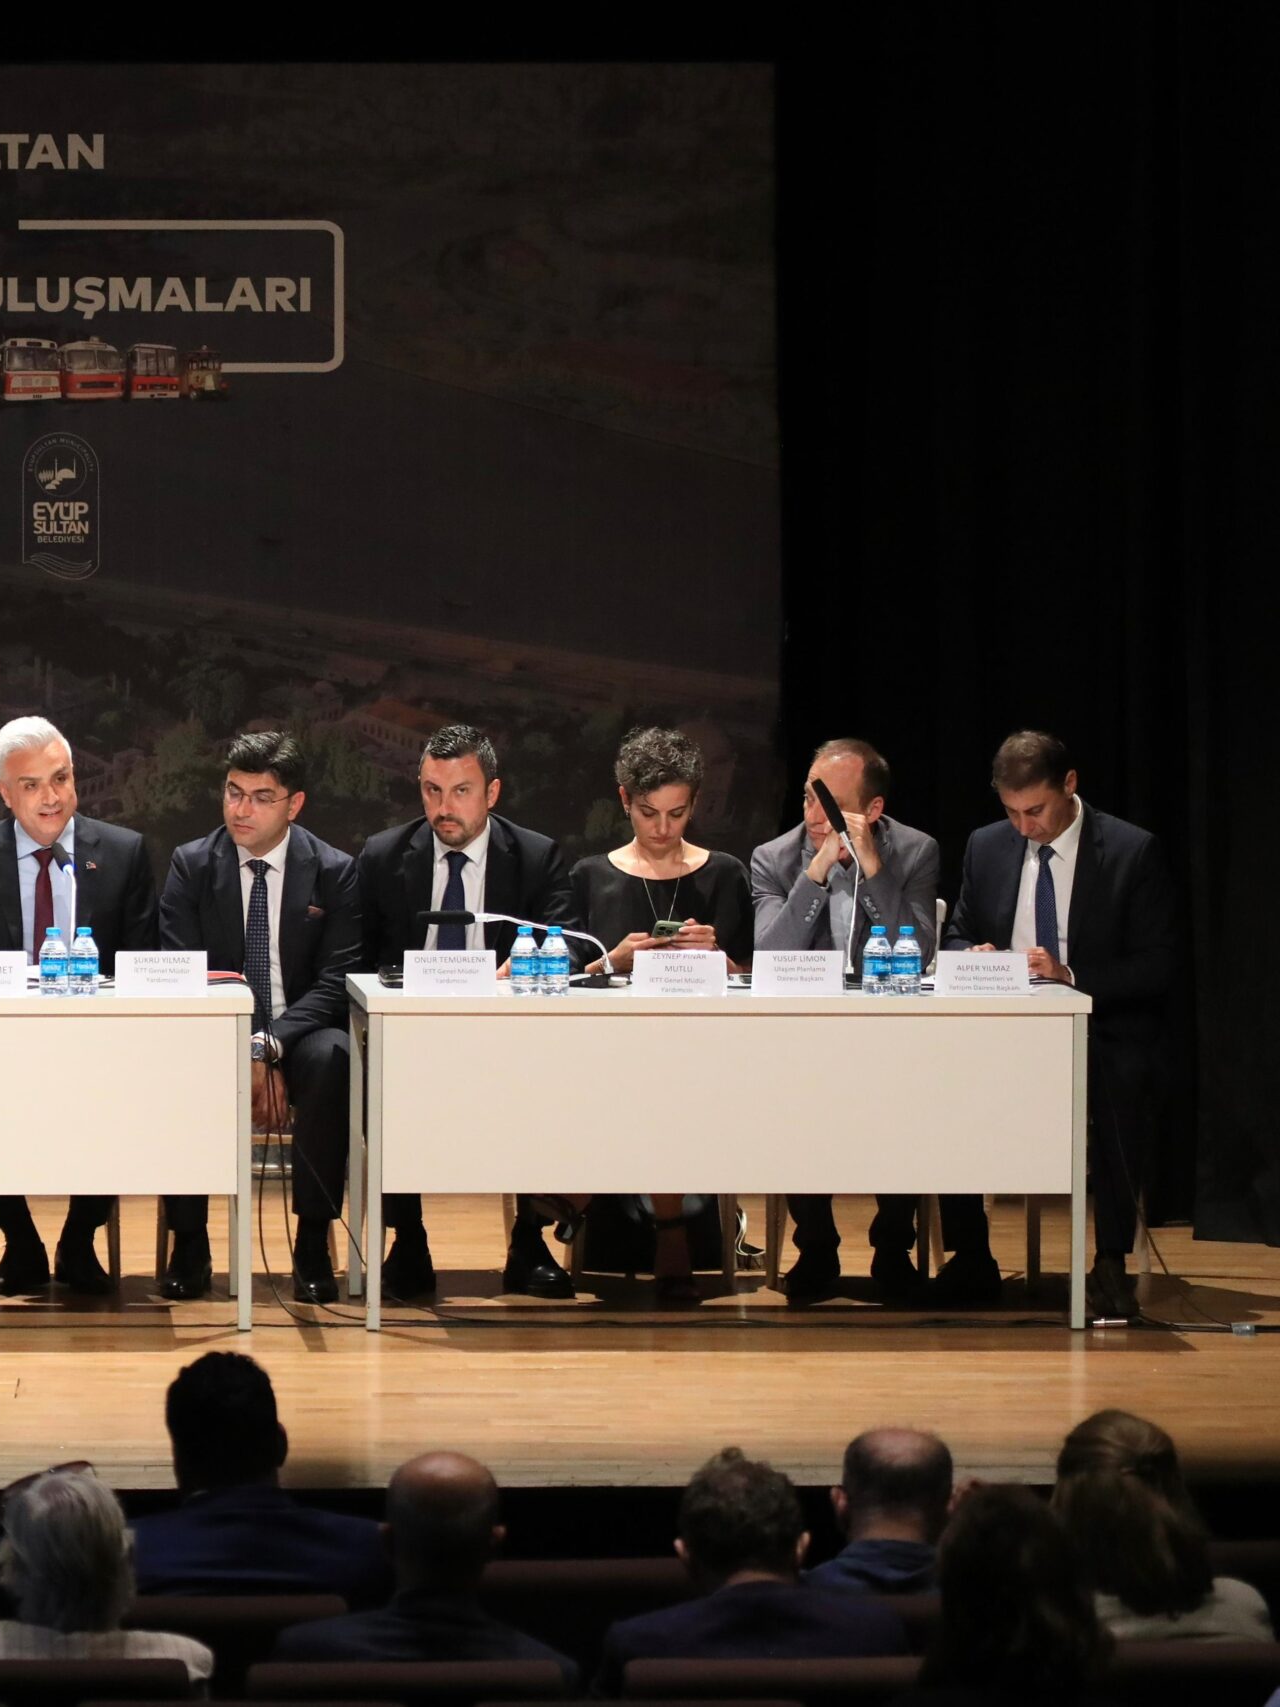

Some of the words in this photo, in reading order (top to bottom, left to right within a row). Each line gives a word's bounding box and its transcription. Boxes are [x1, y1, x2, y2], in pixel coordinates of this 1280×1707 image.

[32, 501, 89, 521] EYÜP
[33, 521, 90, 535] SULTAN
[161, 957, 191, 965] YILMAZ
[414, 956, 437, 964] ONUR
[772, 954, 798, 962] YUSUF
[799, 954, 826, 962] LİMON
[956, 964, 980, 972] ALPER
[981, 964, 1011, 972] YILMAZ
